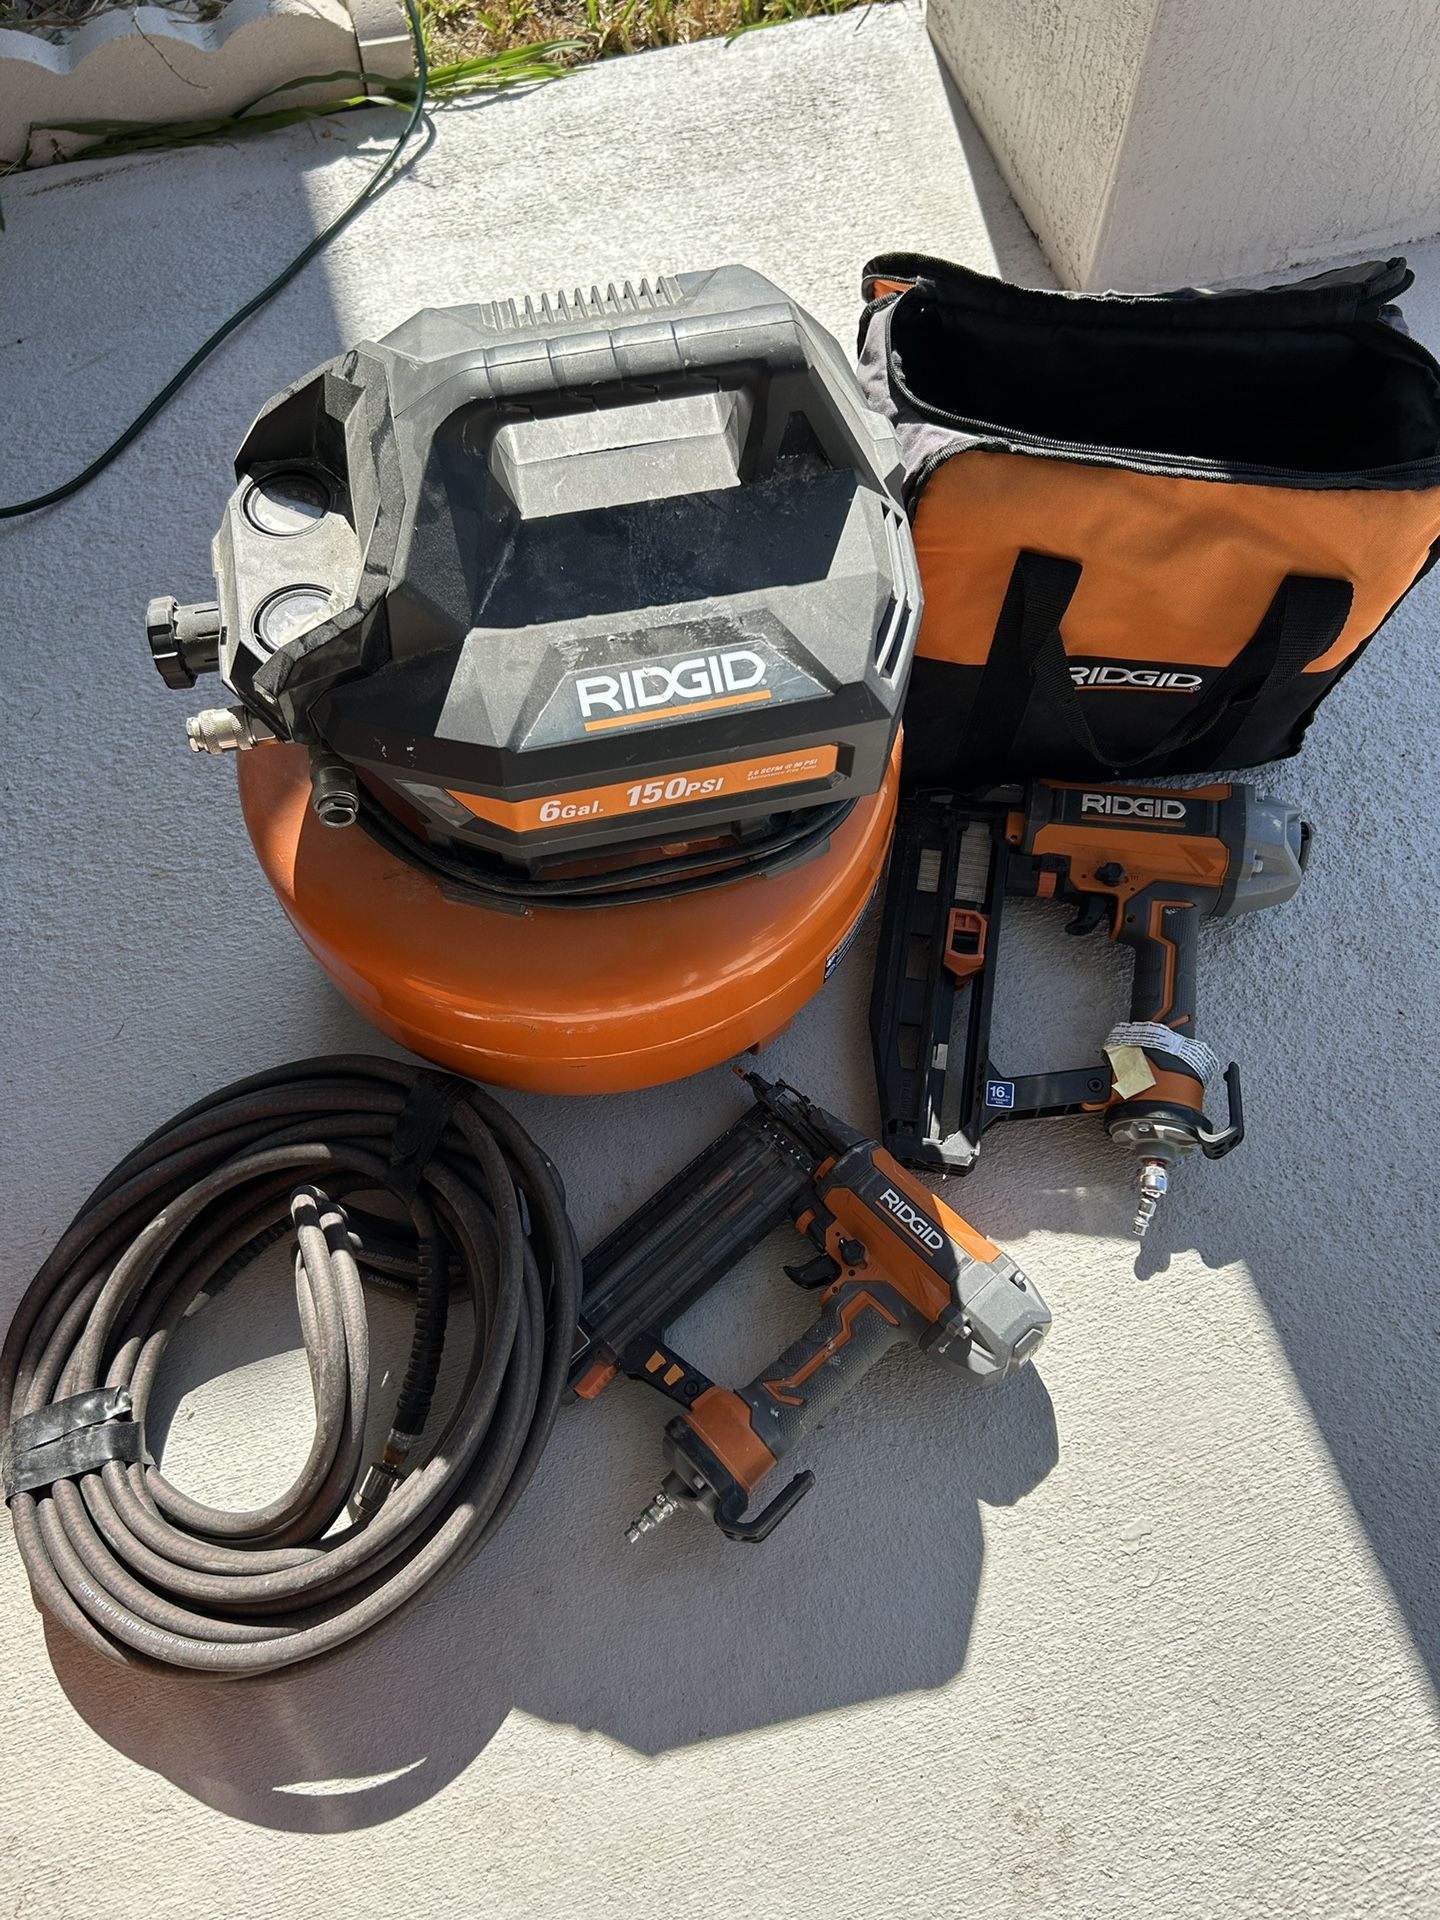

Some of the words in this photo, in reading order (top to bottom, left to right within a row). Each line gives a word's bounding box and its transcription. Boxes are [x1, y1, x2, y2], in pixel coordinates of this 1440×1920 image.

[575, 650, 767, 718] RIDGID
[539, 799, 604, 822] 6Gal.
[1081, 793, 1187, 820] RIDGID
[989, 1086, 1006, 1099] 16
[879, 1188, 944, 1250] RIDGID
[94, 1597, 109, 1612] BAR
[139, 1625, 164, 1641] UTILICE
[163, 1634, 175, 1643] NO
